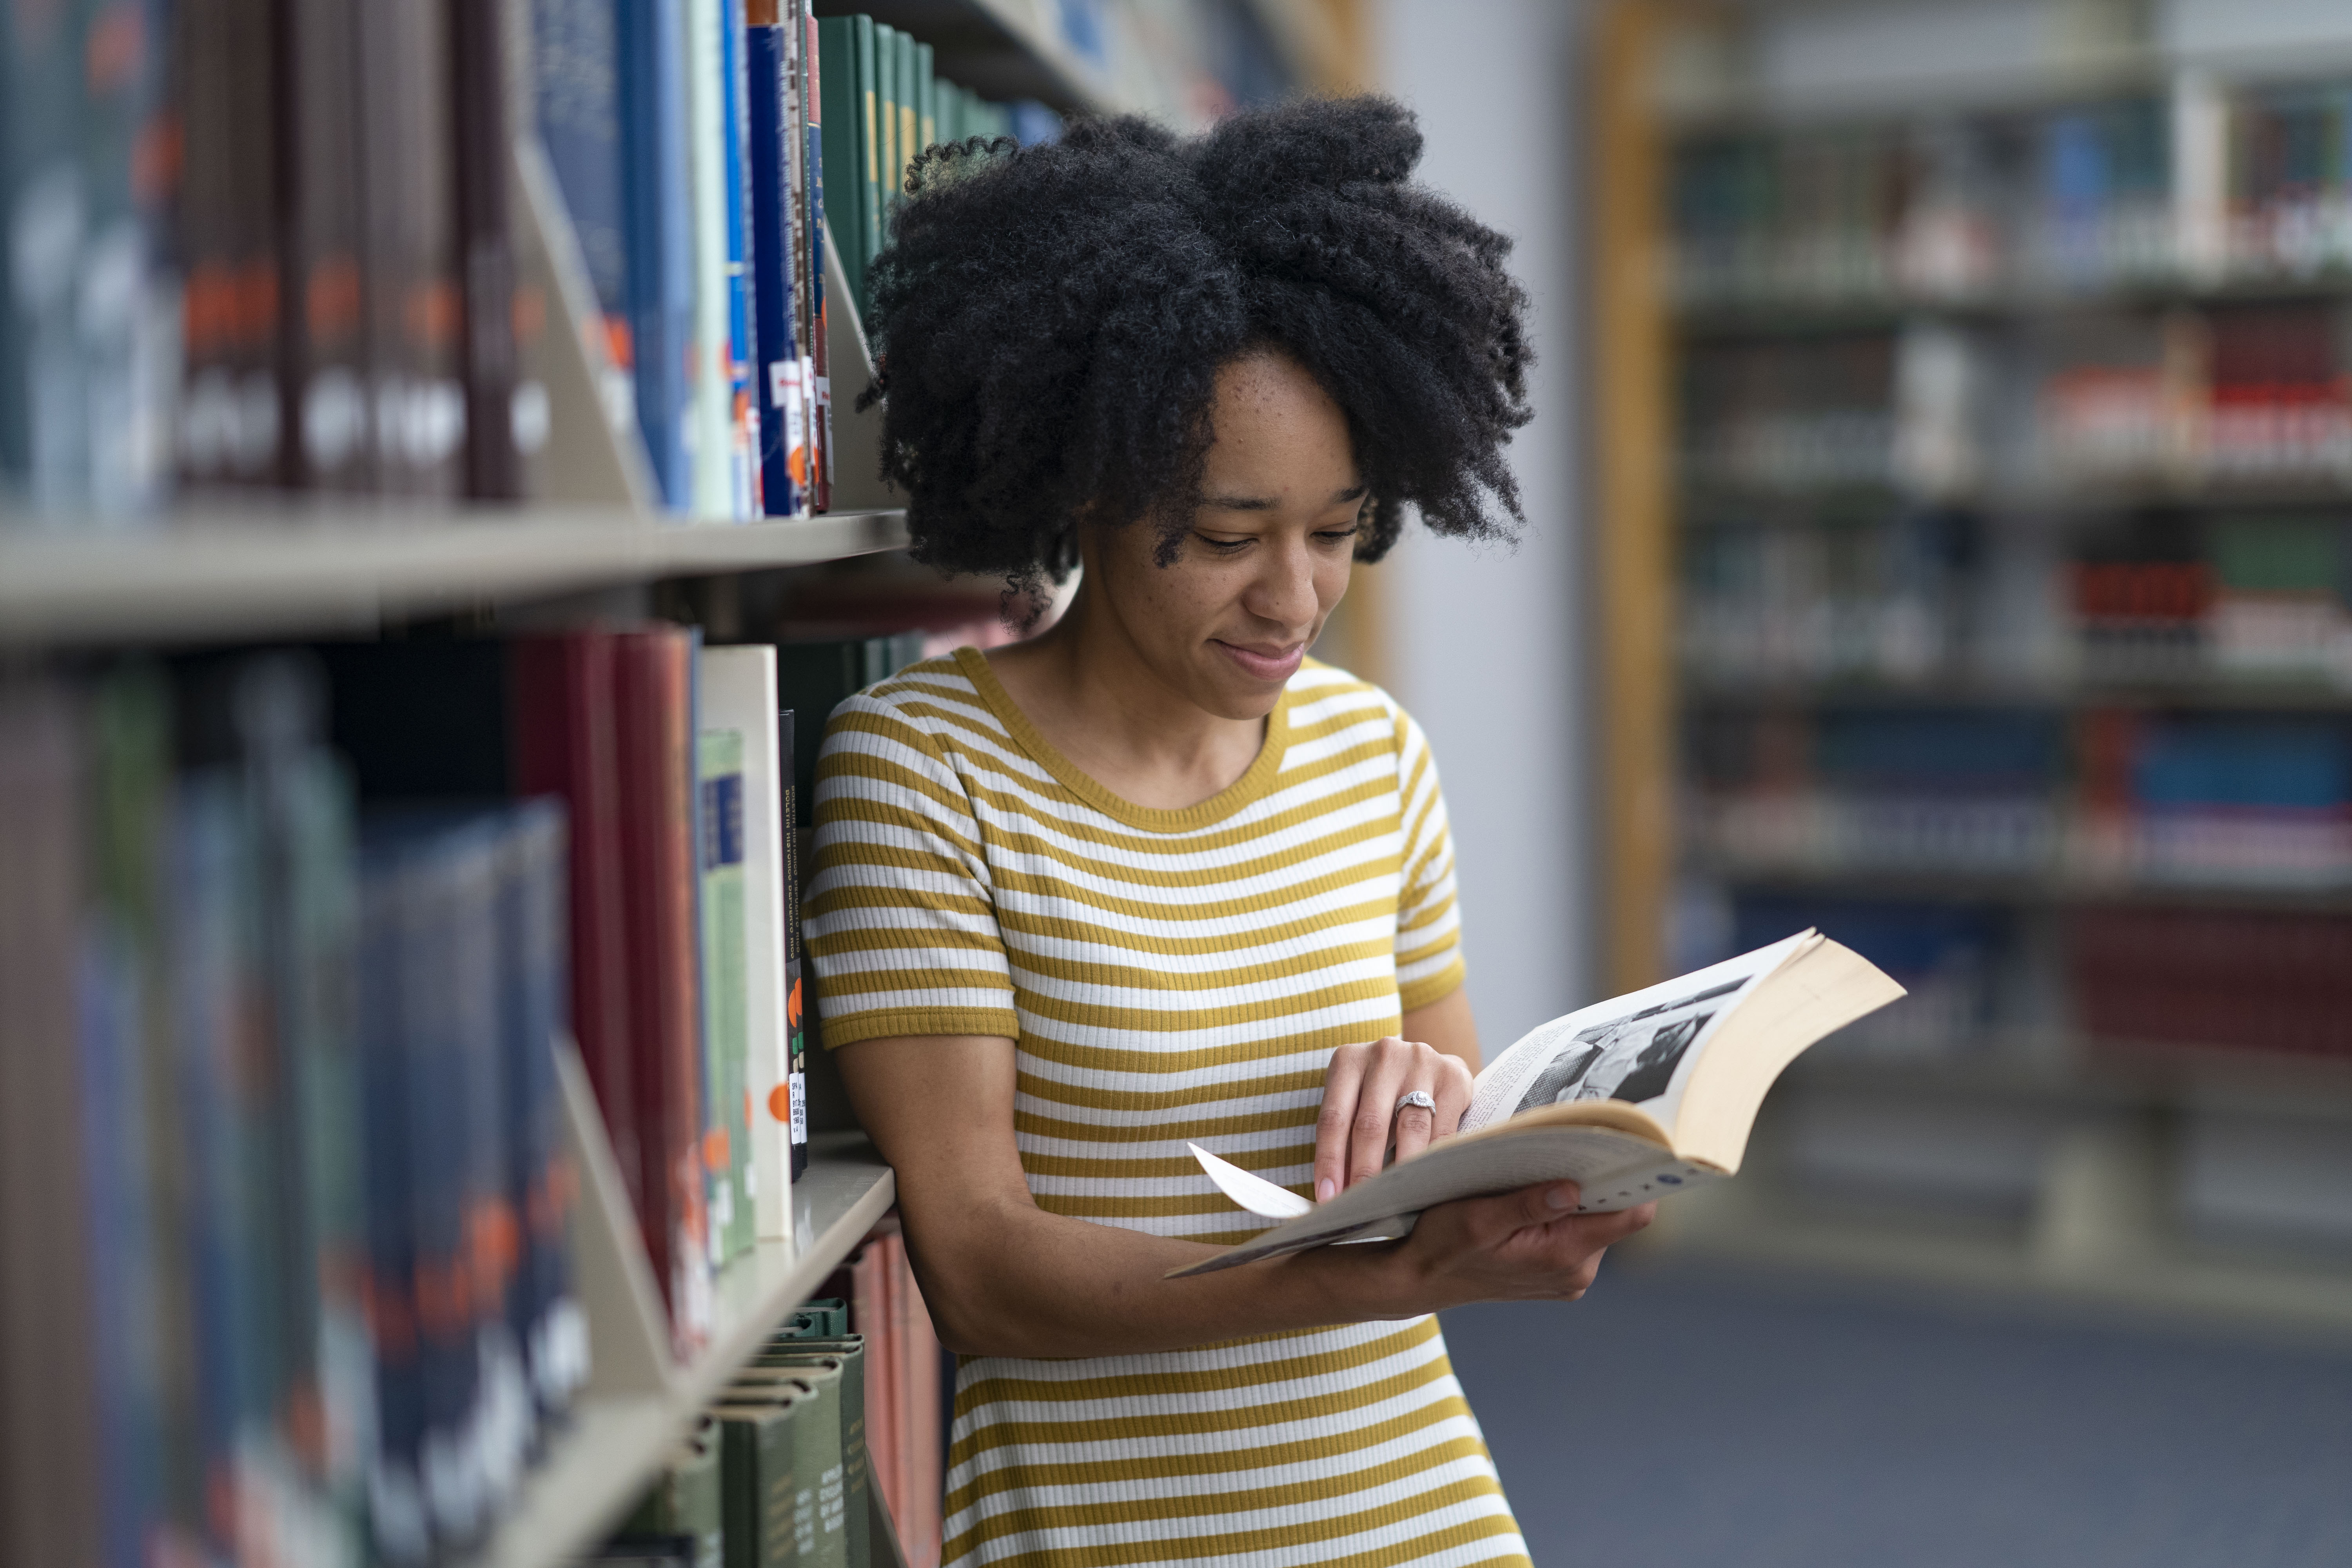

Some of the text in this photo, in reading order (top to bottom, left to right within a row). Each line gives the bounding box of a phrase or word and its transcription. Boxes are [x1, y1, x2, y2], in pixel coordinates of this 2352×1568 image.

[1494, 1071, 1506, 1083] When
[1505, 1063, 1521, 1078] Church
[1494, 1084, 1510, 1102] material
[1496, 1085, 1513, 1105] Reverend
[1472, 1107, 1481, 1117] good
[1473, 1102, 1488, 1121] returned
[1476, 1111, 1486, 1122] been
[1479, 1112, 1490, 1125] many
[1485, 1107, 1497, 1121] Rufus
